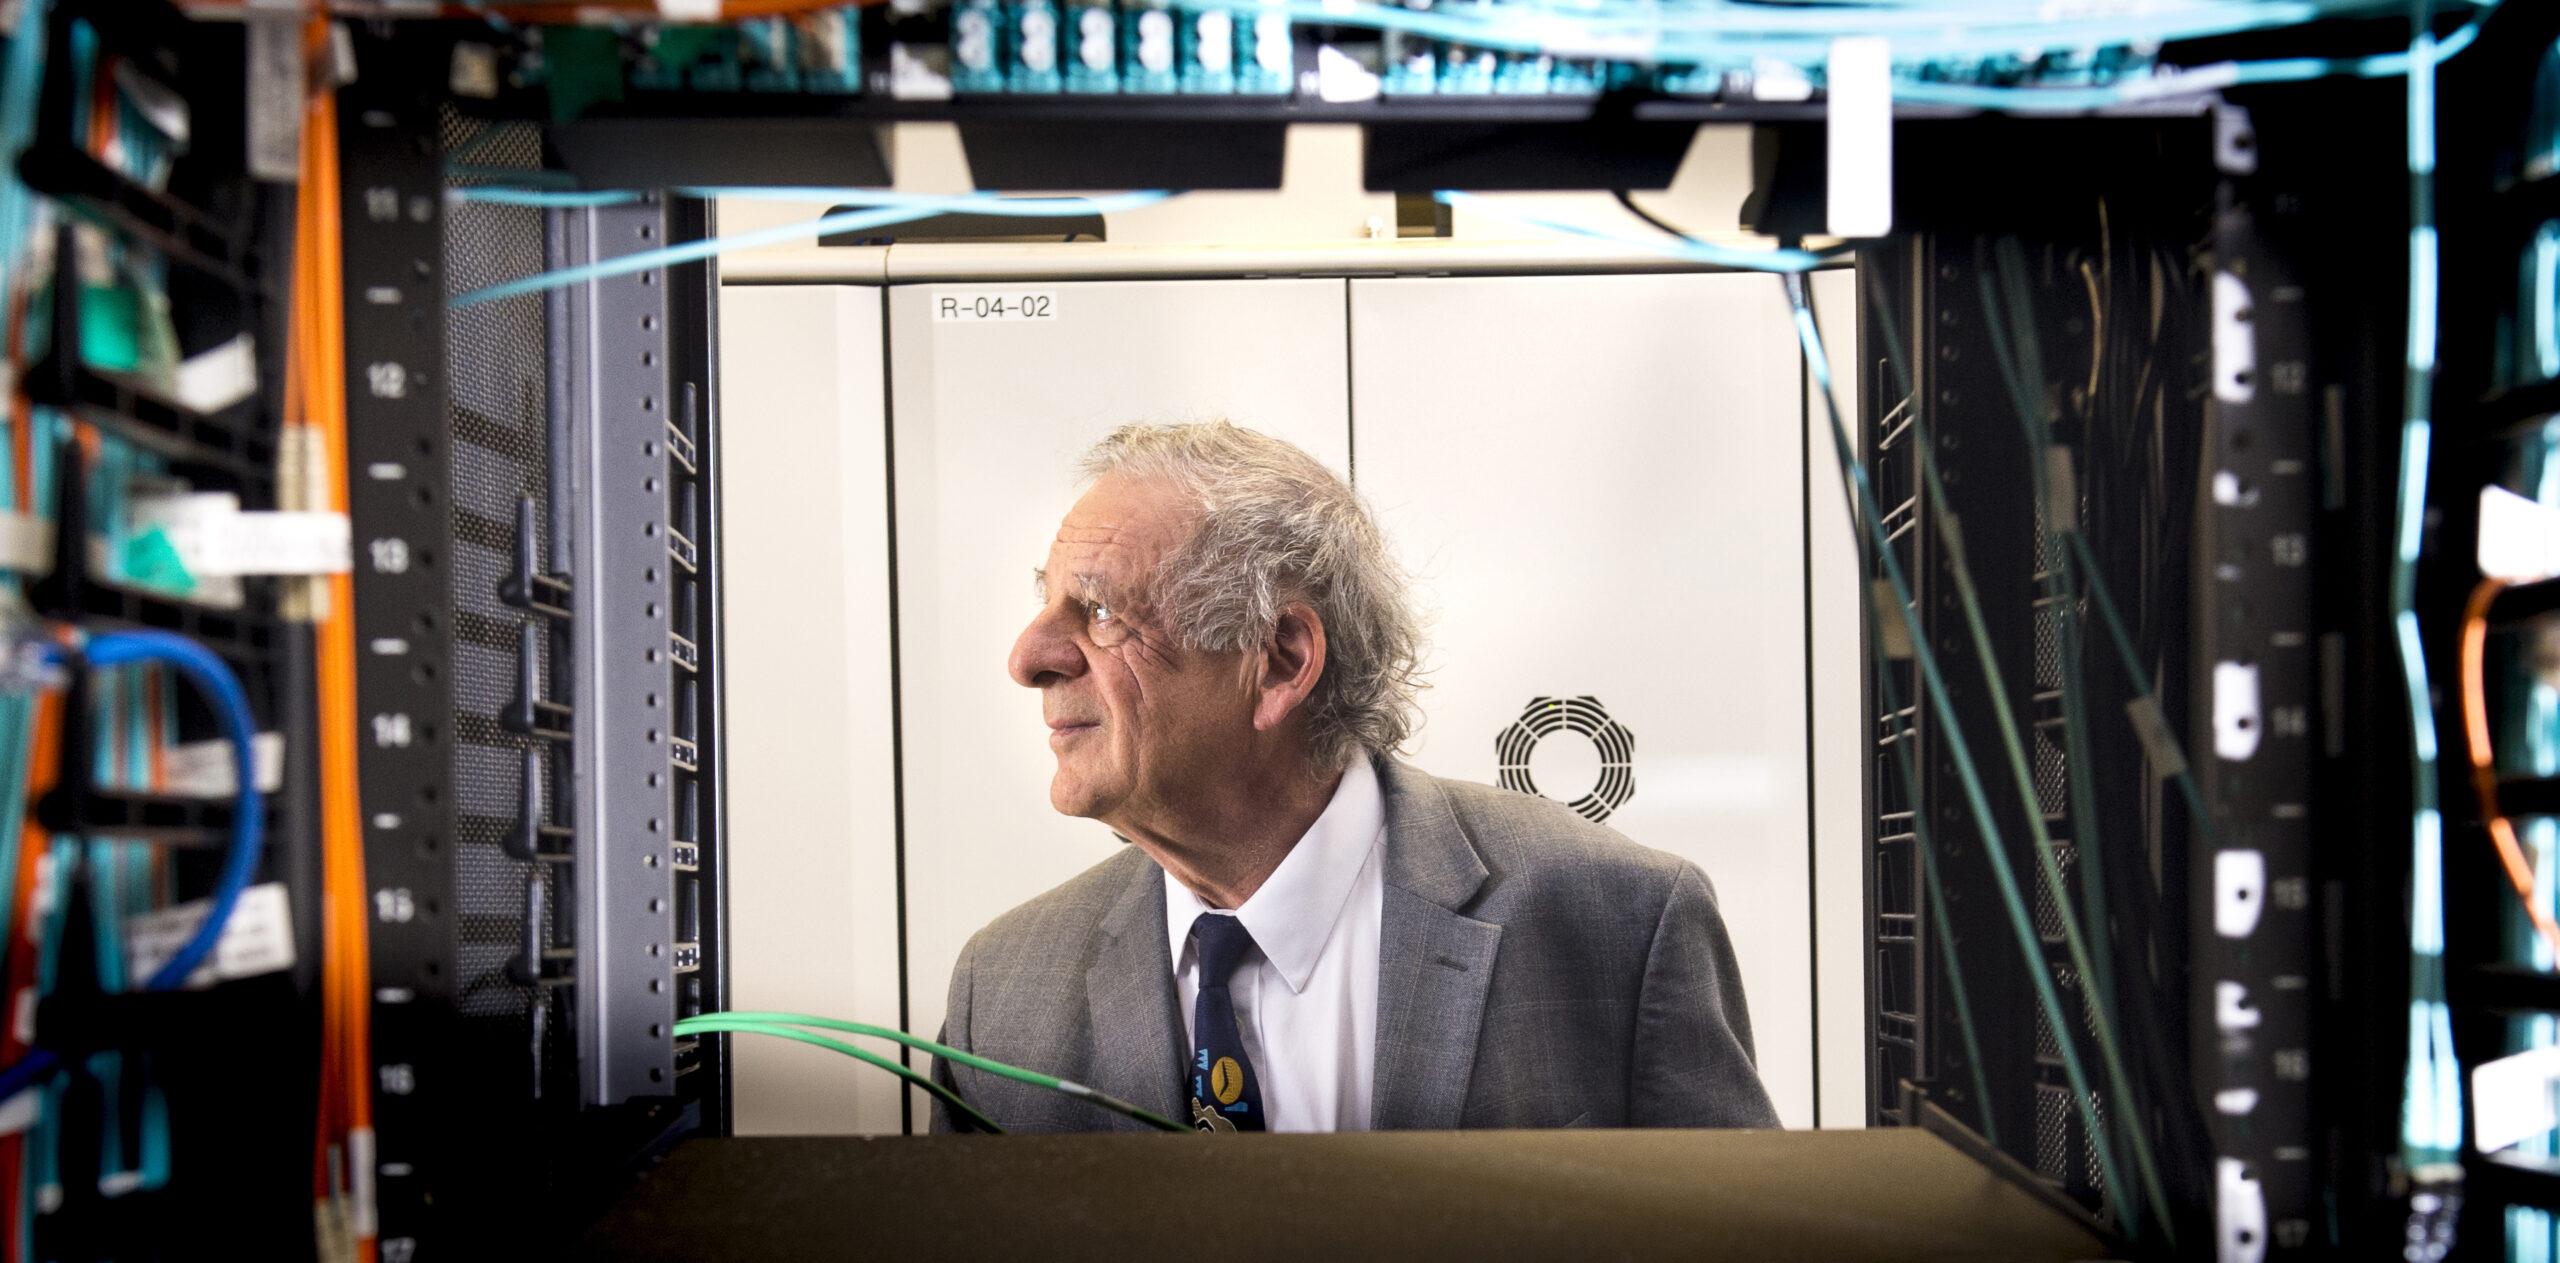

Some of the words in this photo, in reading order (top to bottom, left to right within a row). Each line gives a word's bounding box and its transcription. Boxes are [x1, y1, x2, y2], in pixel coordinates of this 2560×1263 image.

[941, 296, 1051, 318] R-04-02
[368, 363, 405, 399] 12
[375, 888, 414, 922] 15
